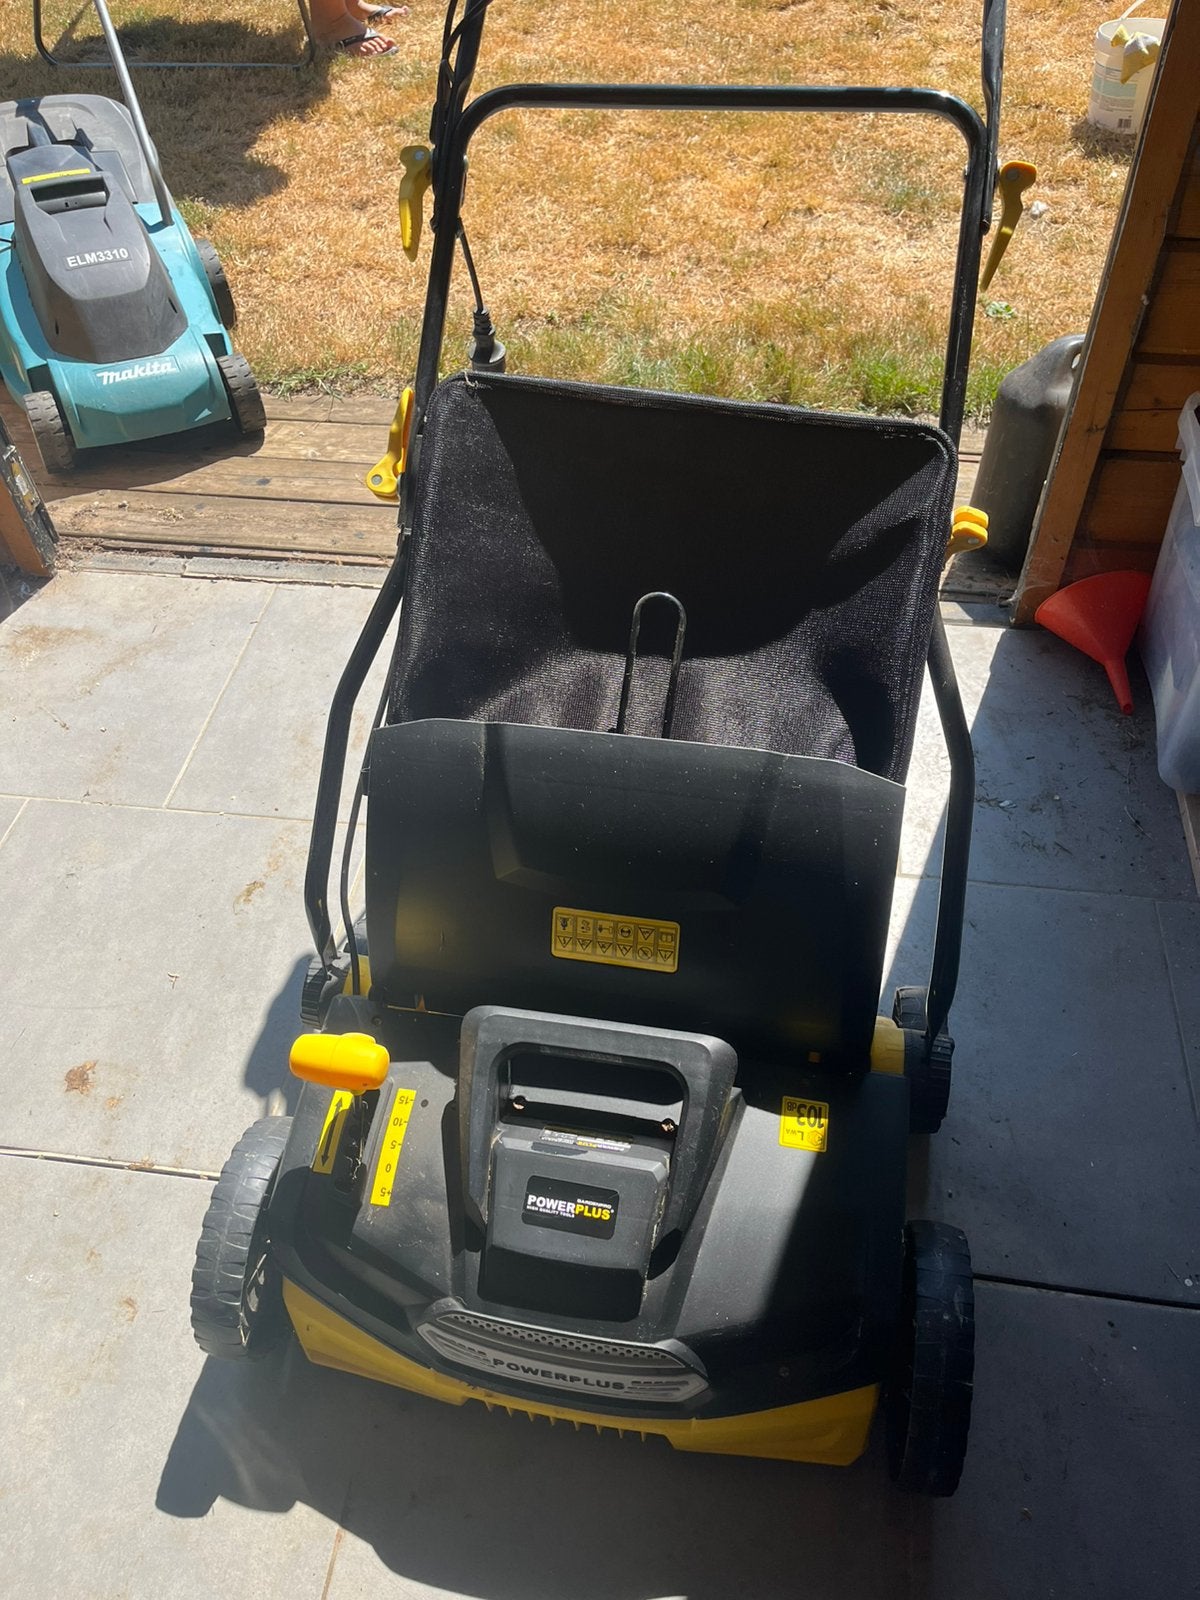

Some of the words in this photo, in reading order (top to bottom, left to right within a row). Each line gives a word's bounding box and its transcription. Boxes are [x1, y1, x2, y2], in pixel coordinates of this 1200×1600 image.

[66, 247, 129, 268] ELM3310
[398, 1095, 415, 1105] -15
[786, 1101, 797, 1111] dB
[796, 1104, 824, 1129] 103
[393, 1117, 408, 1127] -10
[385, 1163, 392, 1173] 0
[380, 1187, 392, 1197] +5
[492, 1357, 626, 1391] POWERPLUS
